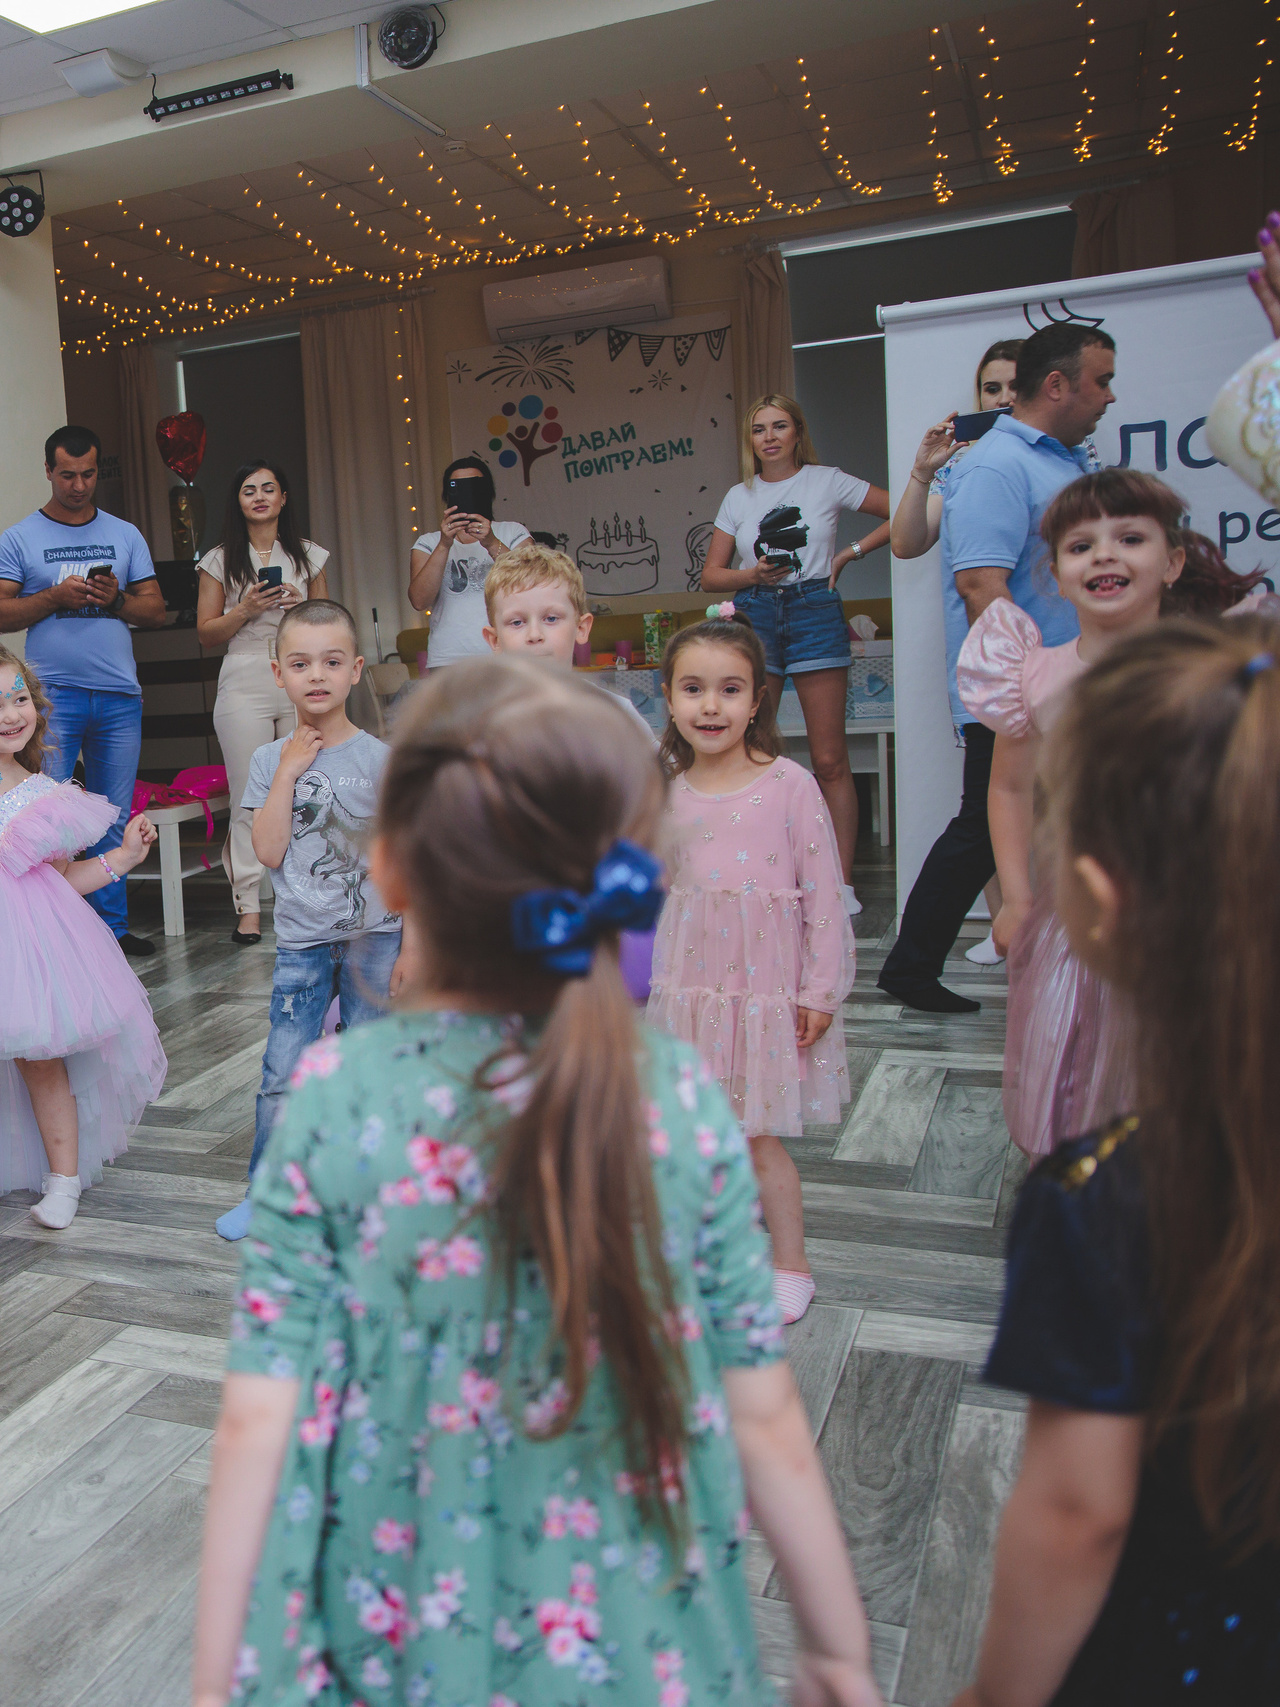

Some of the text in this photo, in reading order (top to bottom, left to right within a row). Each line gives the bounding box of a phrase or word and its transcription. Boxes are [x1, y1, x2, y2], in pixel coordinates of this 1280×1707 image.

[561, 421, 637, 459] ДАВАЙ
[563, 437, 695, 483] ПОИГРАЕМ!
[47, 548, 113, 560] CHAMPIONSHIP
[57, 561, 104, 586] NIK
